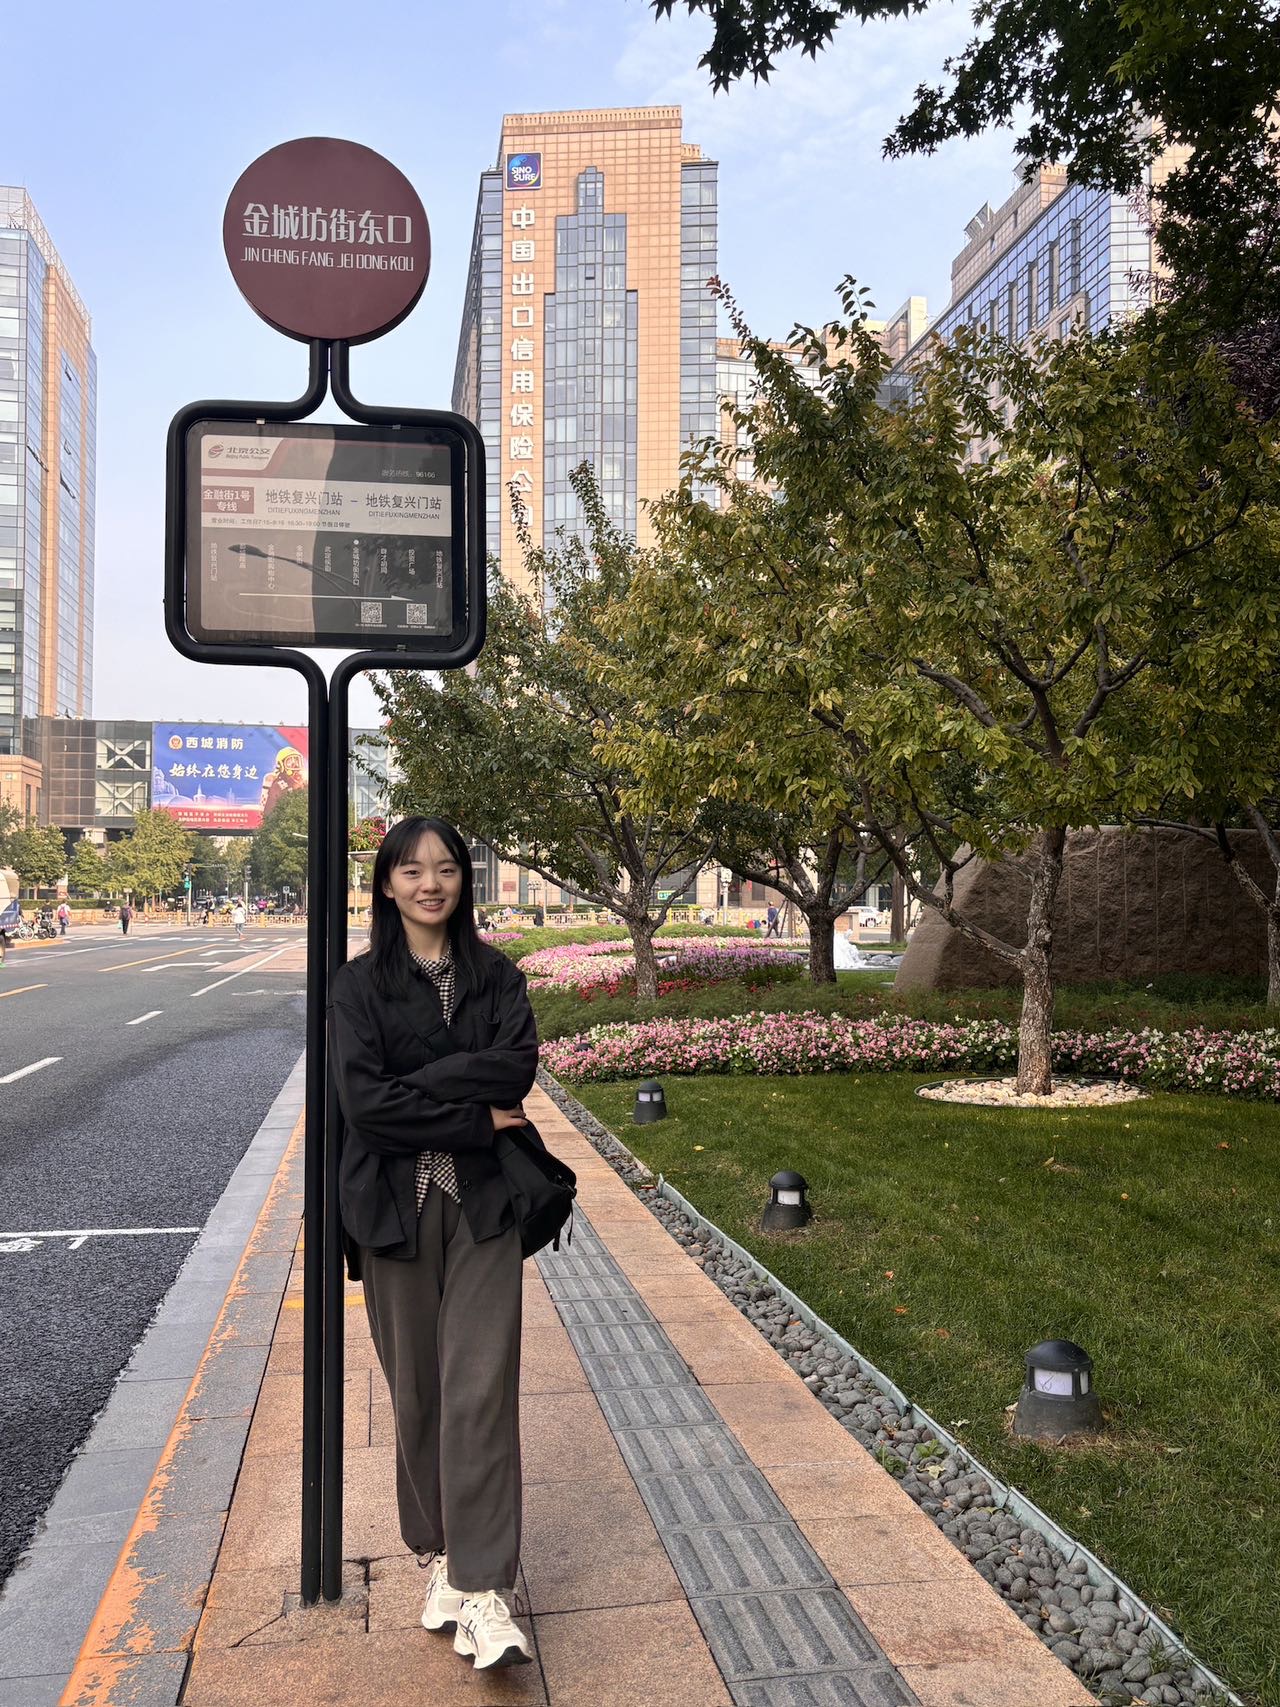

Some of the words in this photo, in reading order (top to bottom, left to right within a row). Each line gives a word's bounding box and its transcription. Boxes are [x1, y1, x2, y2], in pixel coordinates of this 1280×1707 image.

[511, 166, 532, 175] SINO
[513, 173, 536, 182] SURE
[242, 203, 413, 245] 金城坊街东口
[241, 248, 260, 262] JIN
[262, 248, 299, 265] CHENG
[301, 250, 334, 267] FANG
[337, 253, 354, 269] JEI
[357, 254, 388, 271] DONG
[390, 255, 414, 272] KOU
[226, 446, 271, 455] 北京公交
[203, 489, 251, 501] 金融街1号
[265, 489, 343, 506] 地铁复兴门站
[366, 493, 442, 510] 地铁复兴门站
[216, 501, 238, 512] 专线
[267, 507, 341, 516] DITIEFUXINGMENZHAN
[368, 510, 440, 520] DITIEFUXINGMENZHAN
[185, 736, 244, 750] 西城消防
[169, 762, 259, 780] 始终在您身边
